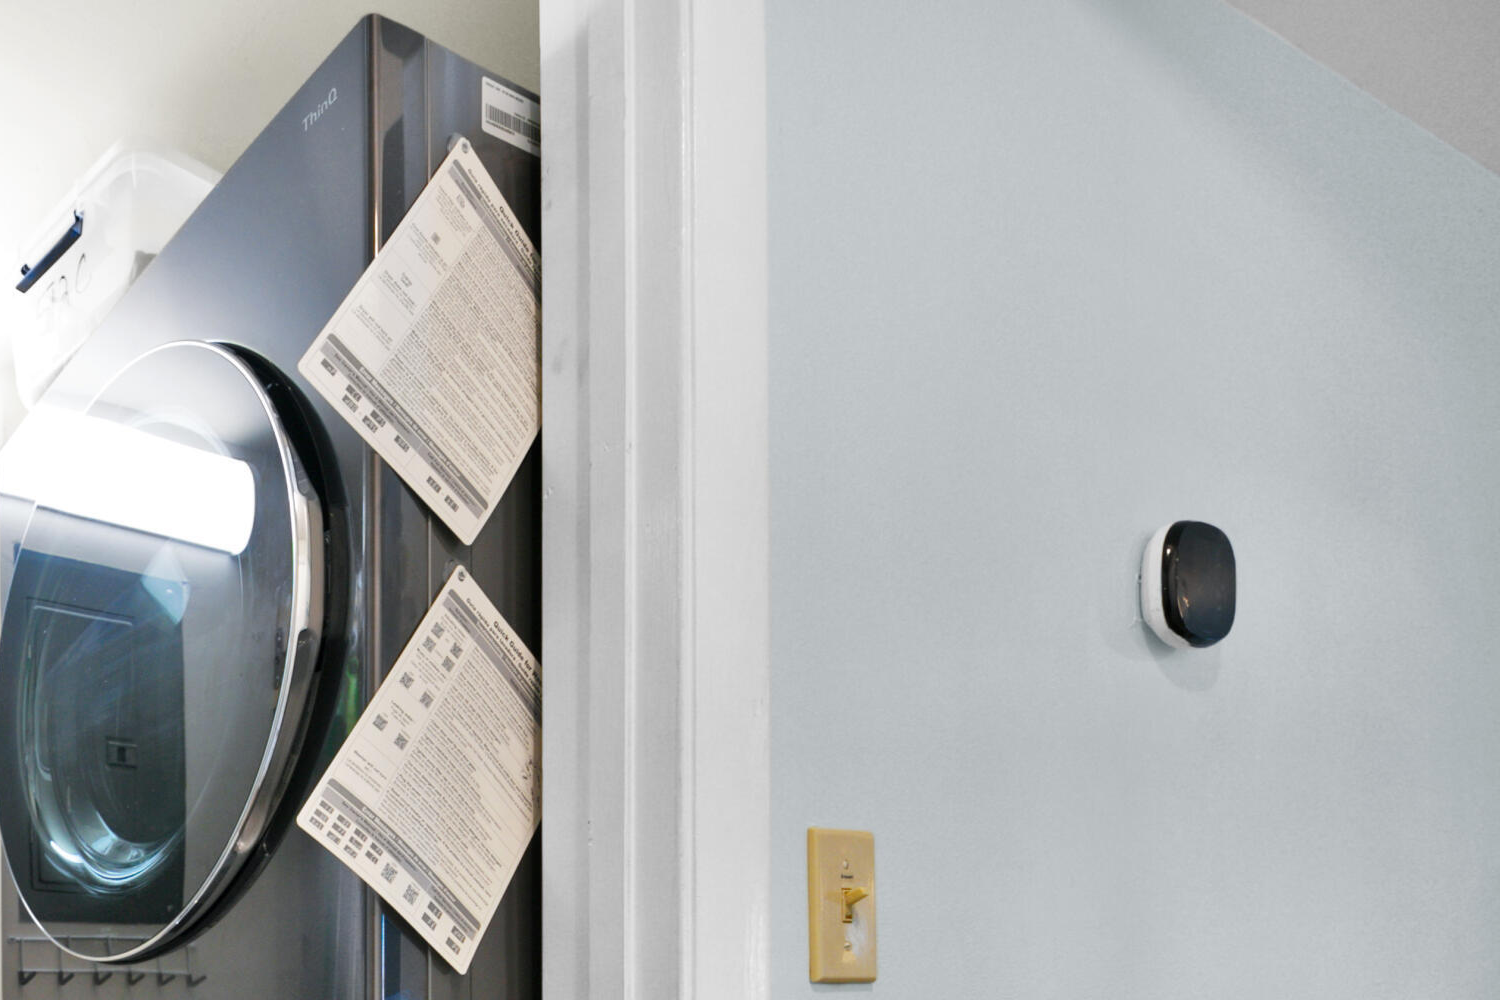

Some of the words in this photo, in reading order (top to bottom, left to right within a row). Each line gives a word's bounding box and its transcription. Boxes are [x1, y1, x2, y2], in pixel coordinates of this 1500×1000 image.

[301, 87, 337, 131] ThinQ
[494, 620, 509, 640] Quick
[509, 640, 524, 660] Guide
